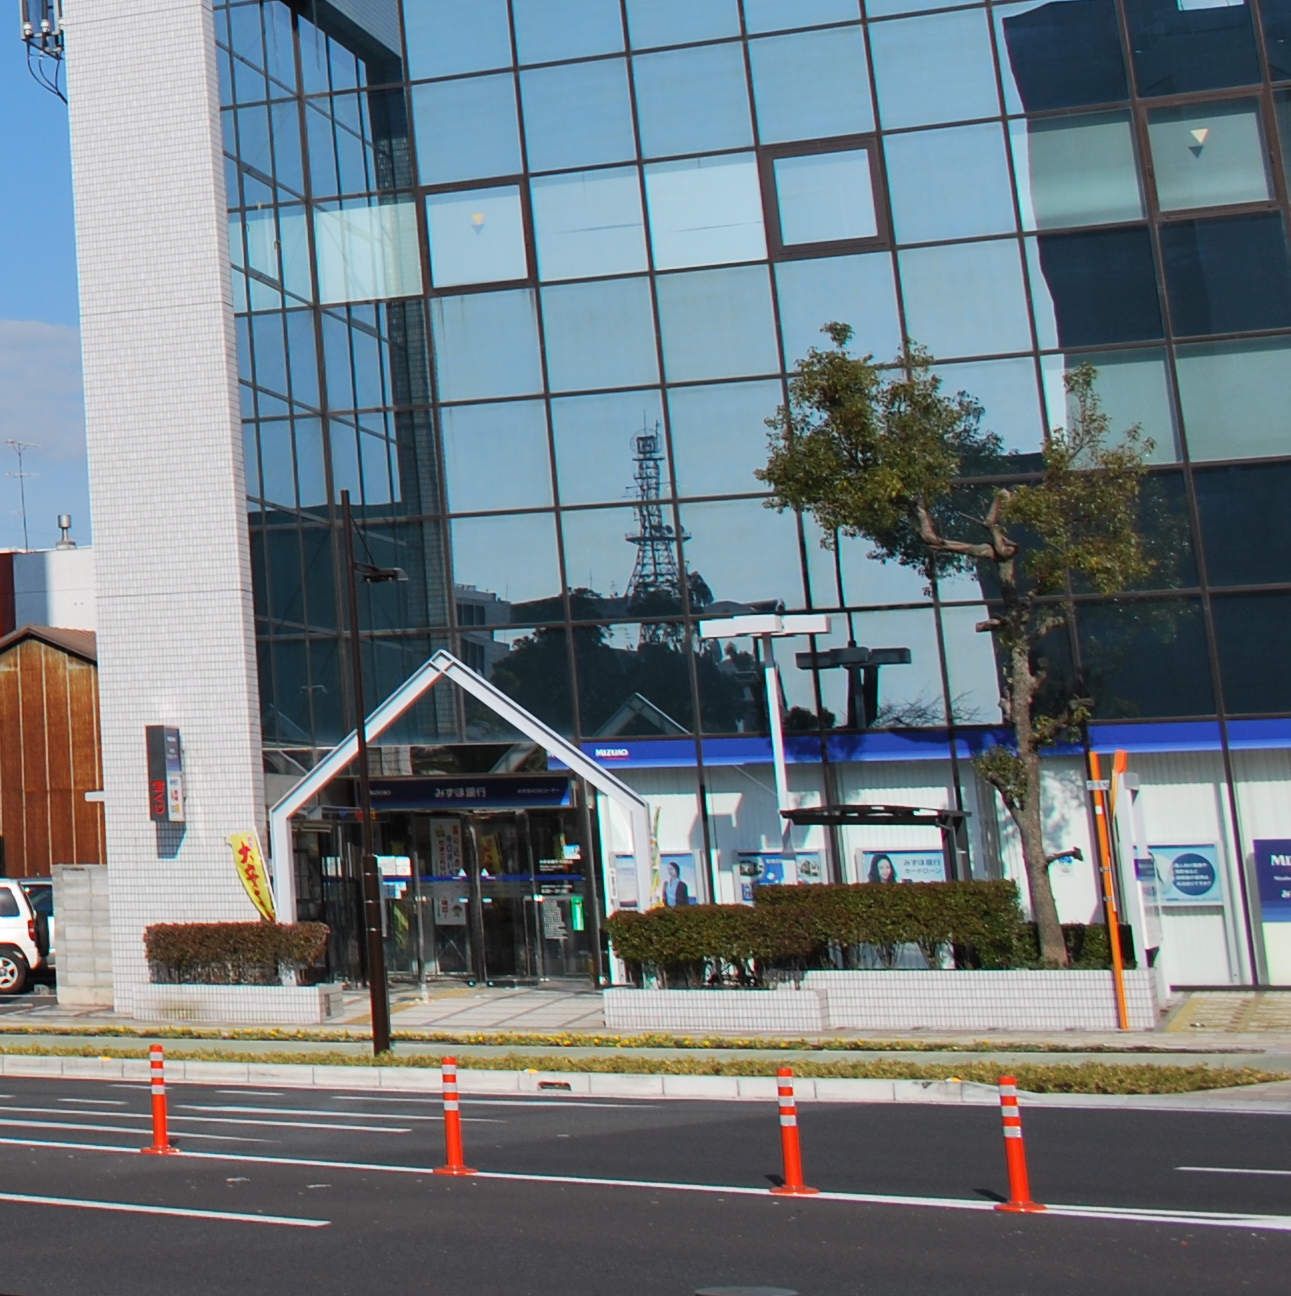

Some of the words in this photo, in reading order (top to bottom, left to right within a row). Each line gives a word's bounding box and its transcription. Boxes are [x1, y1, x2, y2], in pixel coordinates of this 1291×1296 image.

[434, 787, 487, 799] みずほ銀行
